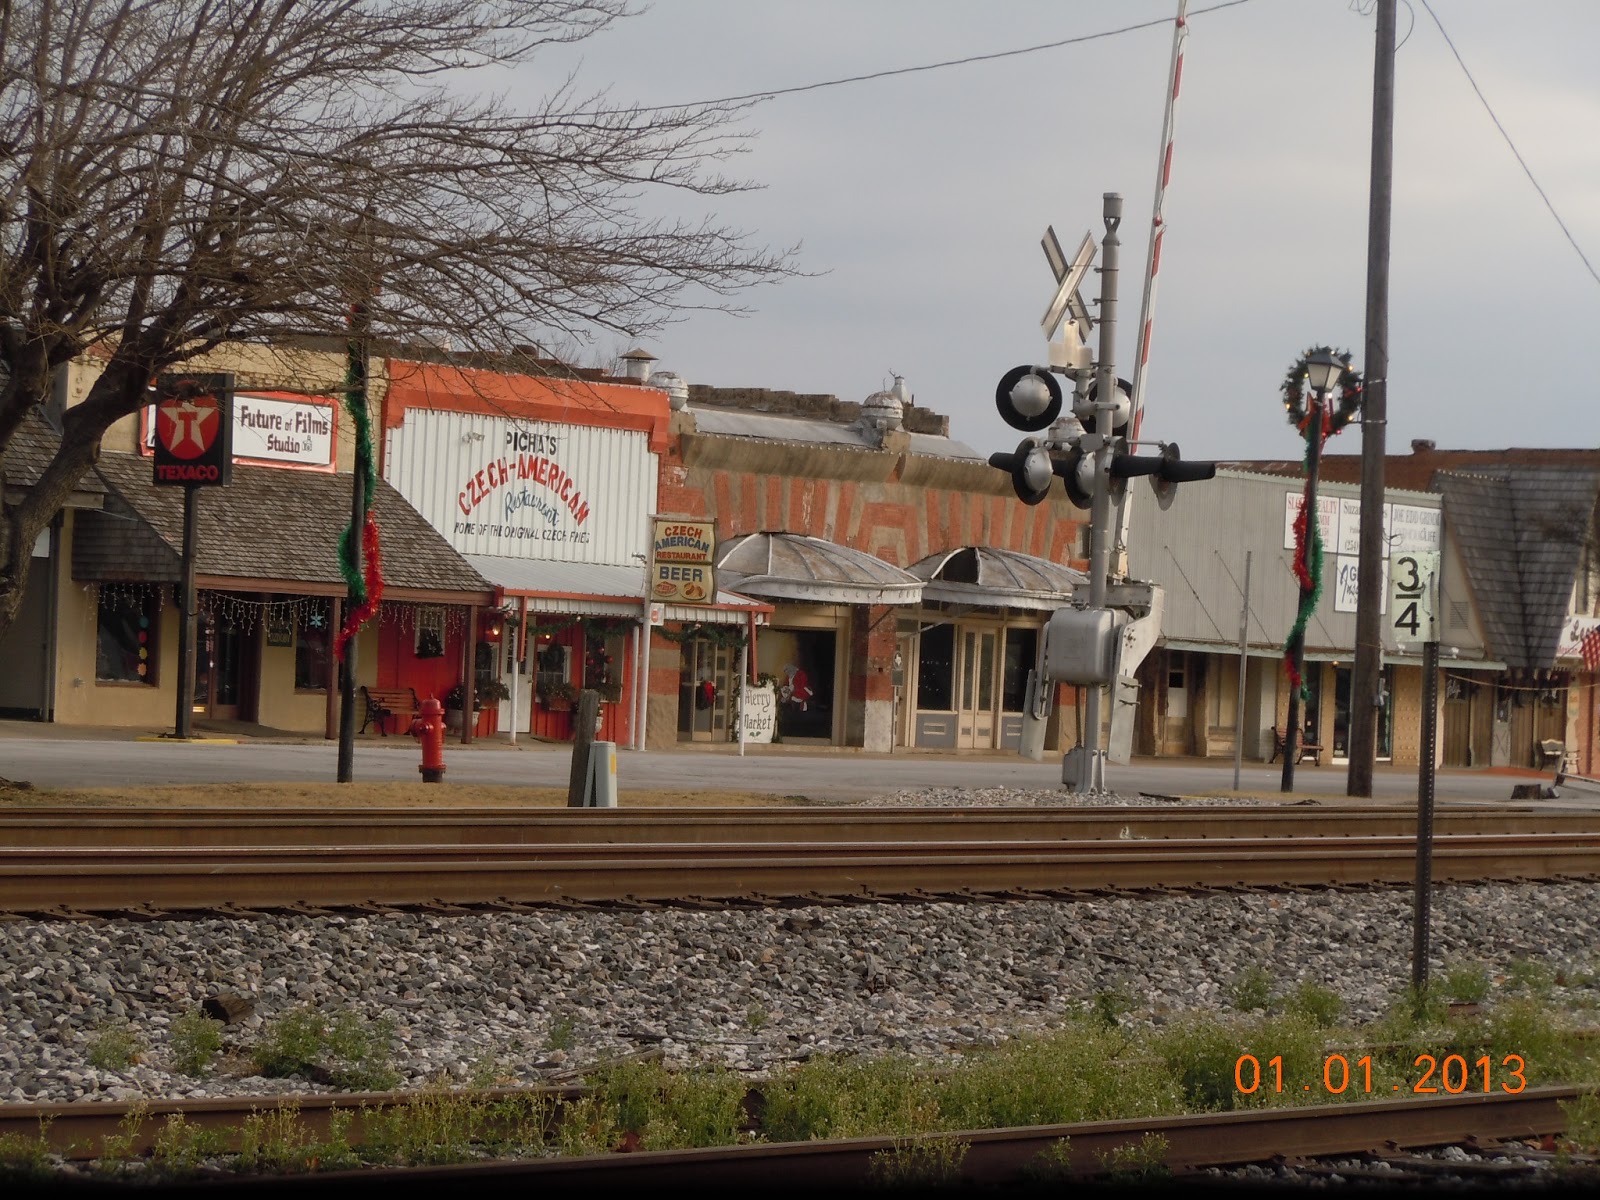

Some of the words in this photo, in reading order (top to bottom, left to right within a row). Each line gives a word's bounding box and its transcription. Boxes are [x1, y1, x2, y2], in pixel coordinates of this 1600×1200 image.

[240, 404, 283, 431] Future
[284, 418, 293, 431] of
[295, 411, 329, 436] Films
[267, 433, 301, 454] Studio
[506, 431, 557, 456] PICHA'S
[157, 464, 219, 481] TEXACO
[453, 521, 476, 535] HOME
[479, 523, 489, 536] OF
[490, 524, 502, 537] THE
[504, 525, 540, 540] ORIGINAL
[542, 529, 567, 542] CZECH
[664, 525, 703, 540] CZECH
[655, 536, 710, 553] AMERICAN
[656, 551, 707, 561] RESTAURANT
[659, 566, 703, 582] BEER
[1396, 556, 1420, 592] 3
[1394, 601, 1421, 637] 4
[744, 688, 771, 713] Merry
